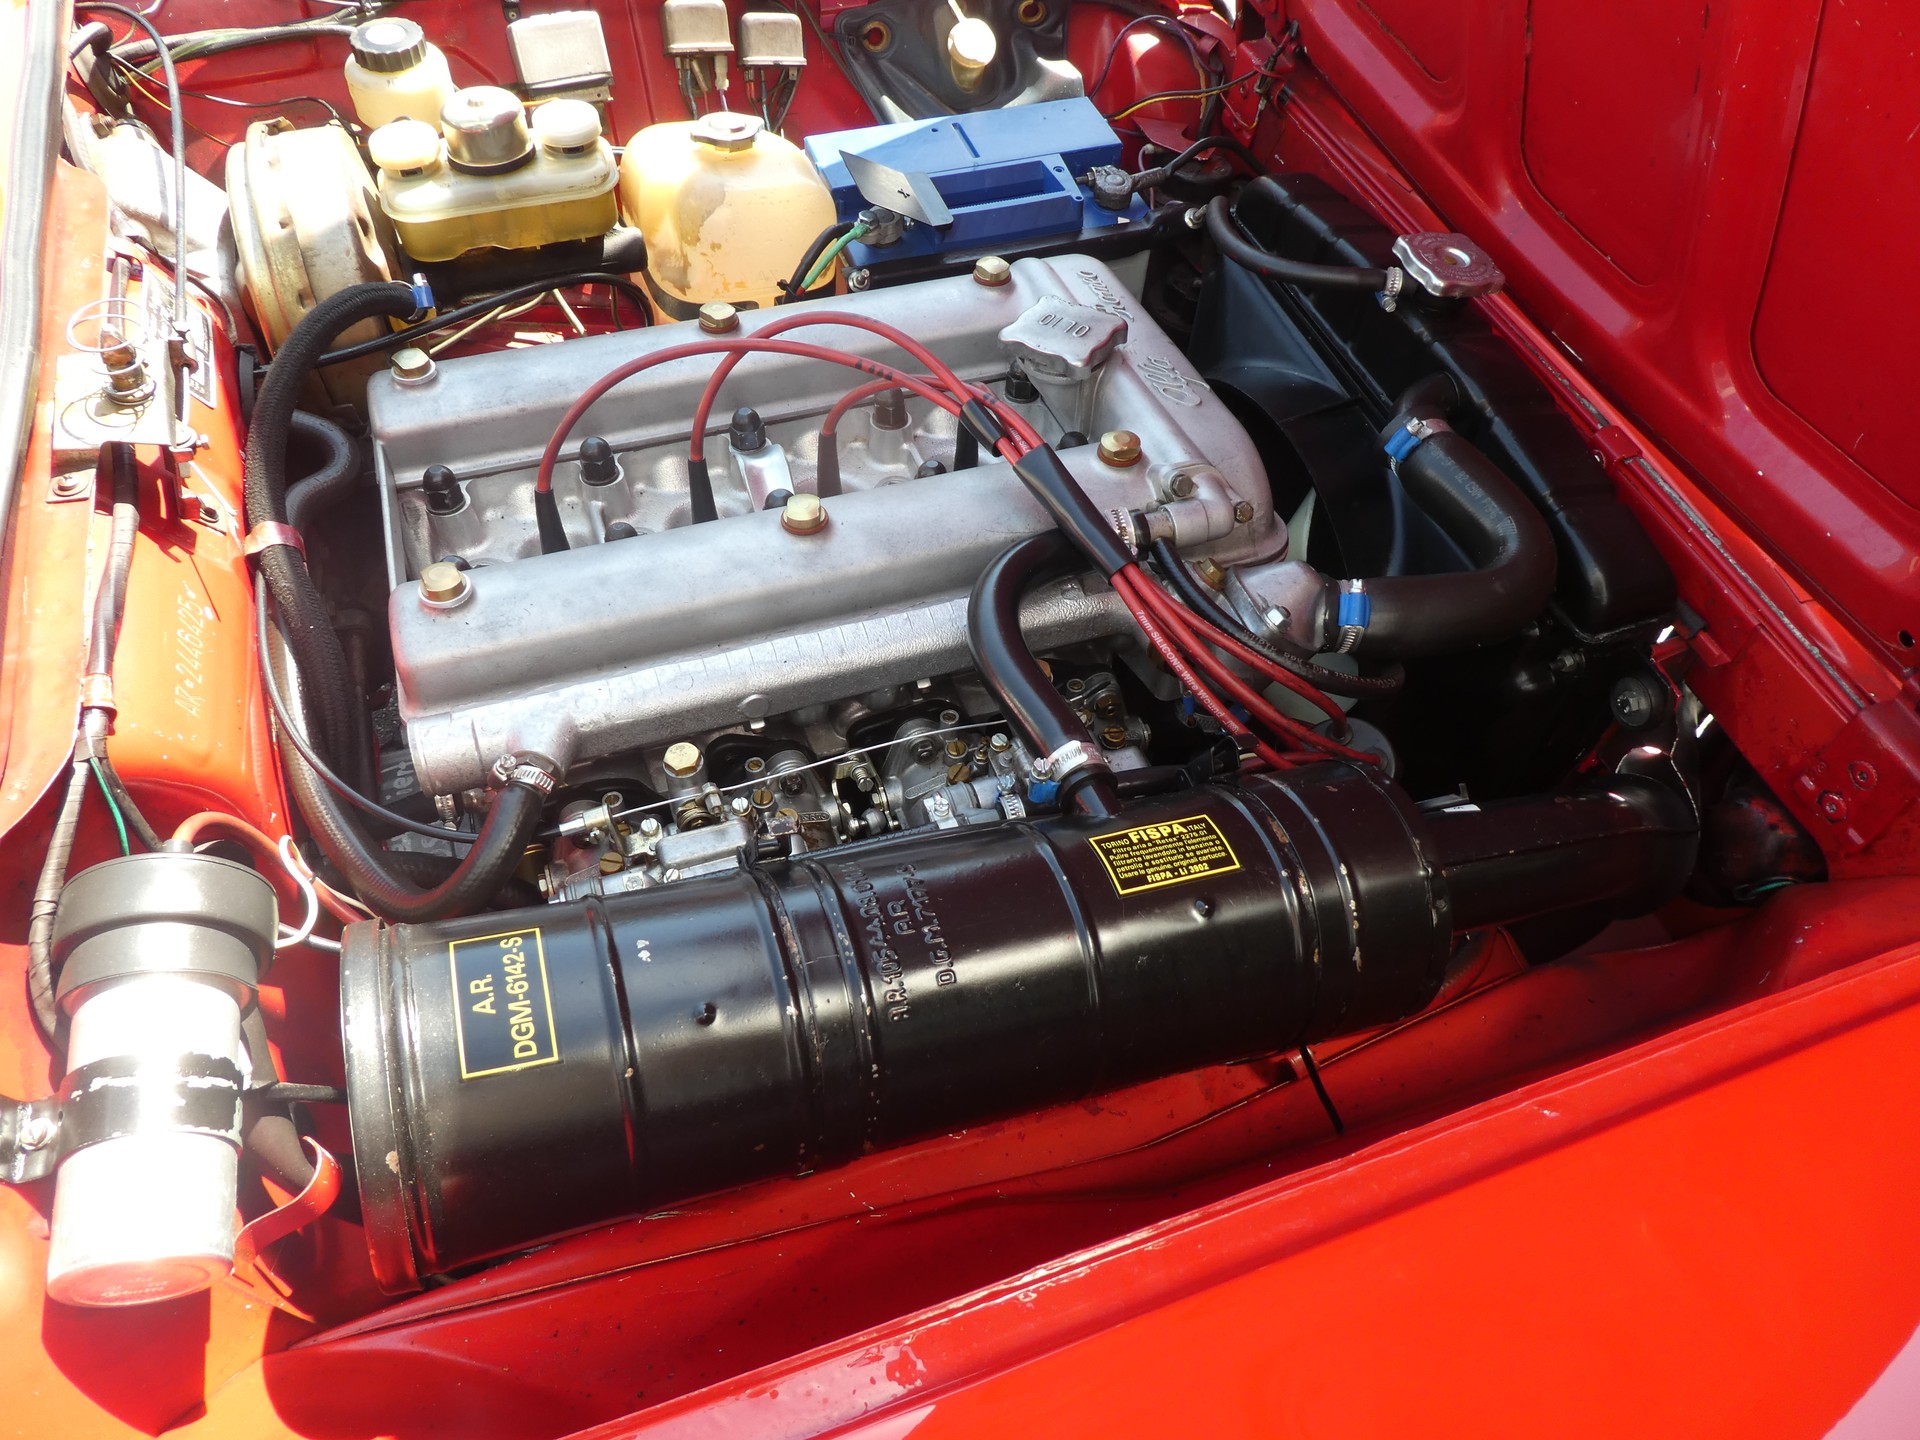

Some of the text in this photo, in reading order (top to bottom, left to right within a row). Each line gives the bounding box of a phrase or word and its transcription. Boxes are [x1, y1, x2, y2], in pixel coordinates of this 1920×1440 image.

[1038, 313, 1091, 338] OLIO
[1136, 610, 1226, 718] 7mm SILICONE Wire Wound
[1101, 822, 1206, 849] TORINO FISPA ITALY
[1130, 841, 1184, 857] frequentemente
[1184, 834, 1217, 845] l'elemento
[1112, 845, 1132, 854] Filtro
[1132, 843, 1147, 851] aria
[1113, 857, 1142, 867] filtrante
[1143, 848, 1177, 860] lavandolo
[1186, 840, 1214, 851] benzina
[1116, 863, 1143, 874] petrolio
[1119, 869, 1139, 879] Usare
[1173, 856, 1199, 867] originali
[1146, 871, 1174, 883] FISPA
[1188, 863, 1210, 874] 3902
[469, 973, 497, 1015] A.R.
[499, 936, 538, 1059] DGM-6142-S
